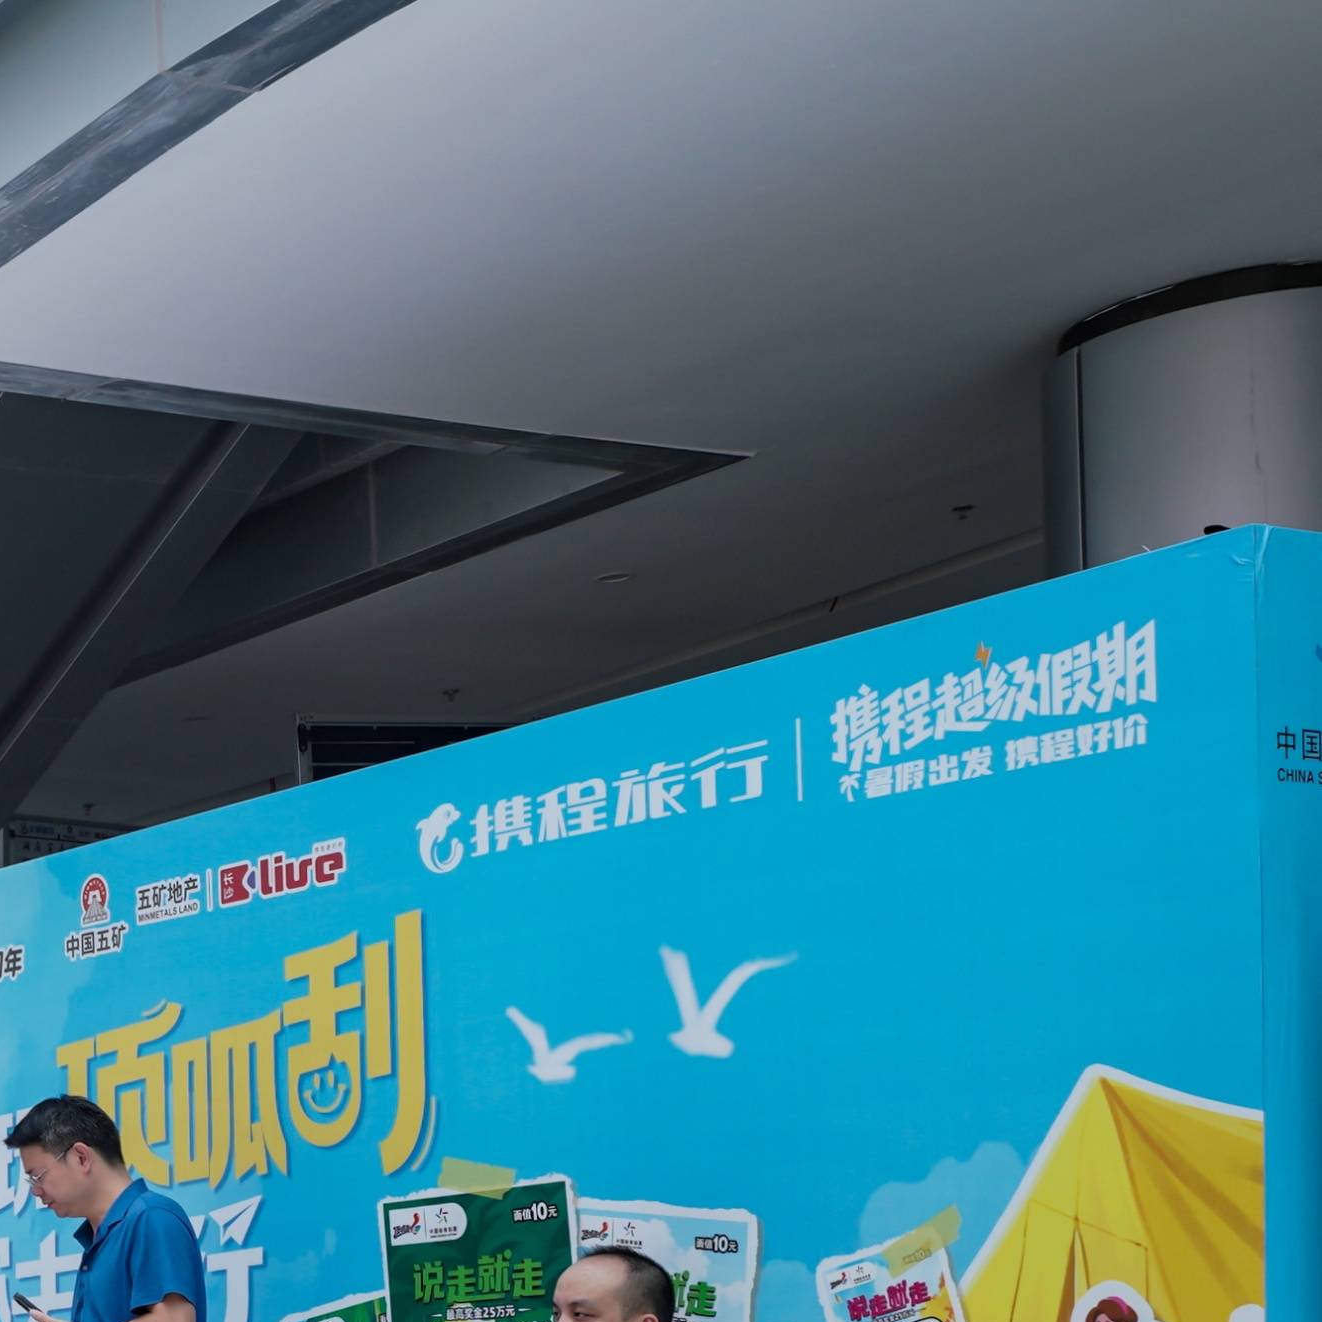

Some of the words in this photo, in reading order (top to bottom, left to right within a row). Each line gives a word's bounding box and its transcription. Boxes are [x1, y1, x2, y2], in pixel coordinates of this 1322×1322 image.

[829, 618, 1159, 772] 携程超级假期
[863, 748, 994, 801] 暑假出发
[1005, 711, 1148, 780] 携程好价
[1276, 725, 1322, 761] 中国
[1277, 767, 1314, 784] CHINA
[470, 737, 769, 859] 携程旅行
[136, 876, 199, 912] 五矿地产
[137, 907, 176, 923] MINMETALS
[177, 901, 199, 917] LAND
[65, 923, 127, 957] 中国五矿
[512, 1201, 558, 1222] 面值10元
[694, 1233, 739, 1254] 面值10元
[413, 1250, 547, 1303] 说走就走
[445, 1304, 516, 1321] 最高奖金25万元
[846, 1279, 932, 1322] 说走就走
